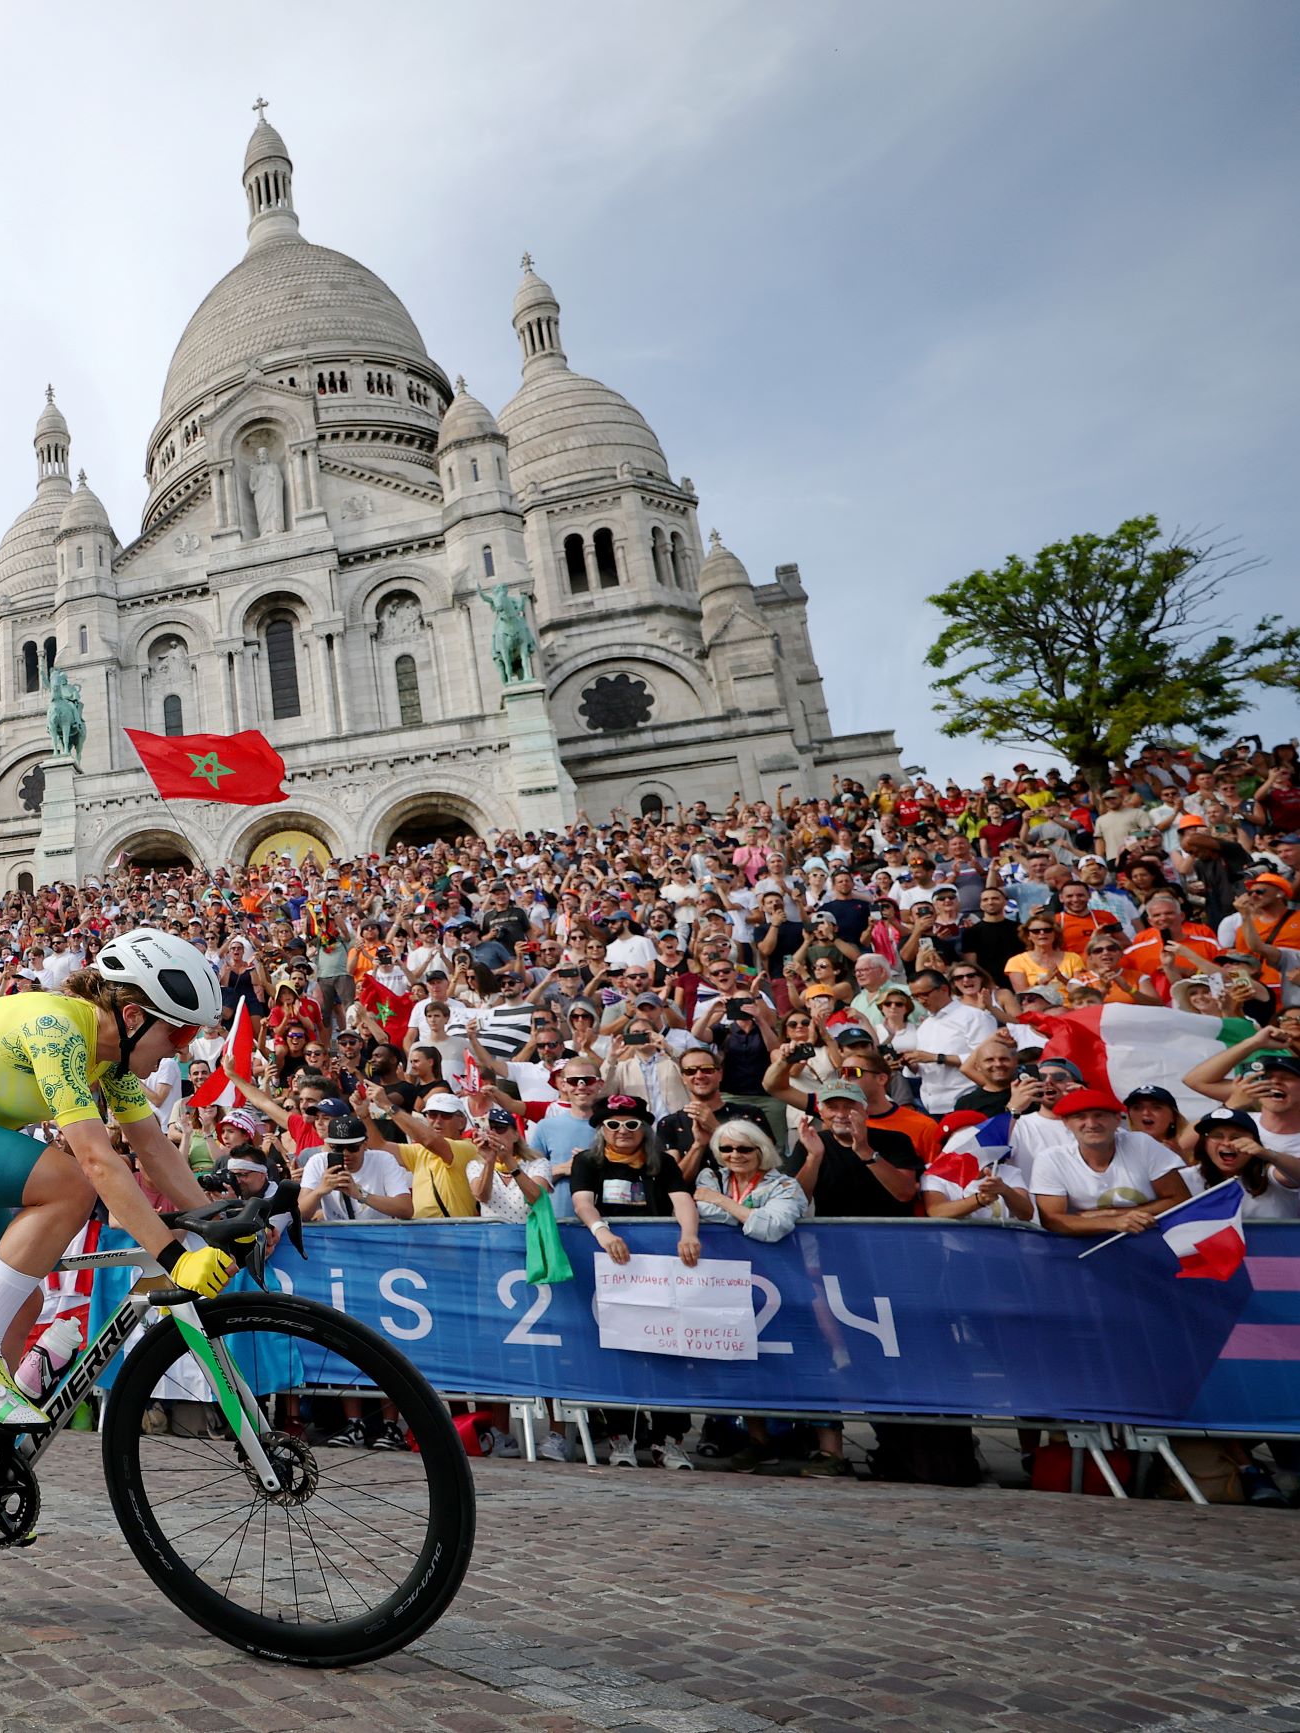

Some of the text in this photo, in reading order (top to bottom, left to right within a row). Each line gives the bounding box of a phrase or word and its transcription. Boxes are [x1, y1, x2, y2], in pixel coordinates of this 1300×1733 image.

[130, 945, 154, 969] LAZER
[68, 1251, 128, 1263] LAPIERRE
[602, 1274, 609, 1285] I
[612, 1274, 626, 1285] AM
[630, 1275, 670, 1287] NUMBER
[675, 1275, 694, 1286] ONE
[725, 1278, 751, 1288] WORLD
[226, 1316, 314, 1332] DURA-ACE
[644, 1325, 741, 1338] CLIP OFFICIEL
[658, 1339, 746, 1352] SUR YOUTUBE
[393, 1541, 443, 1618] DURA-ACE
